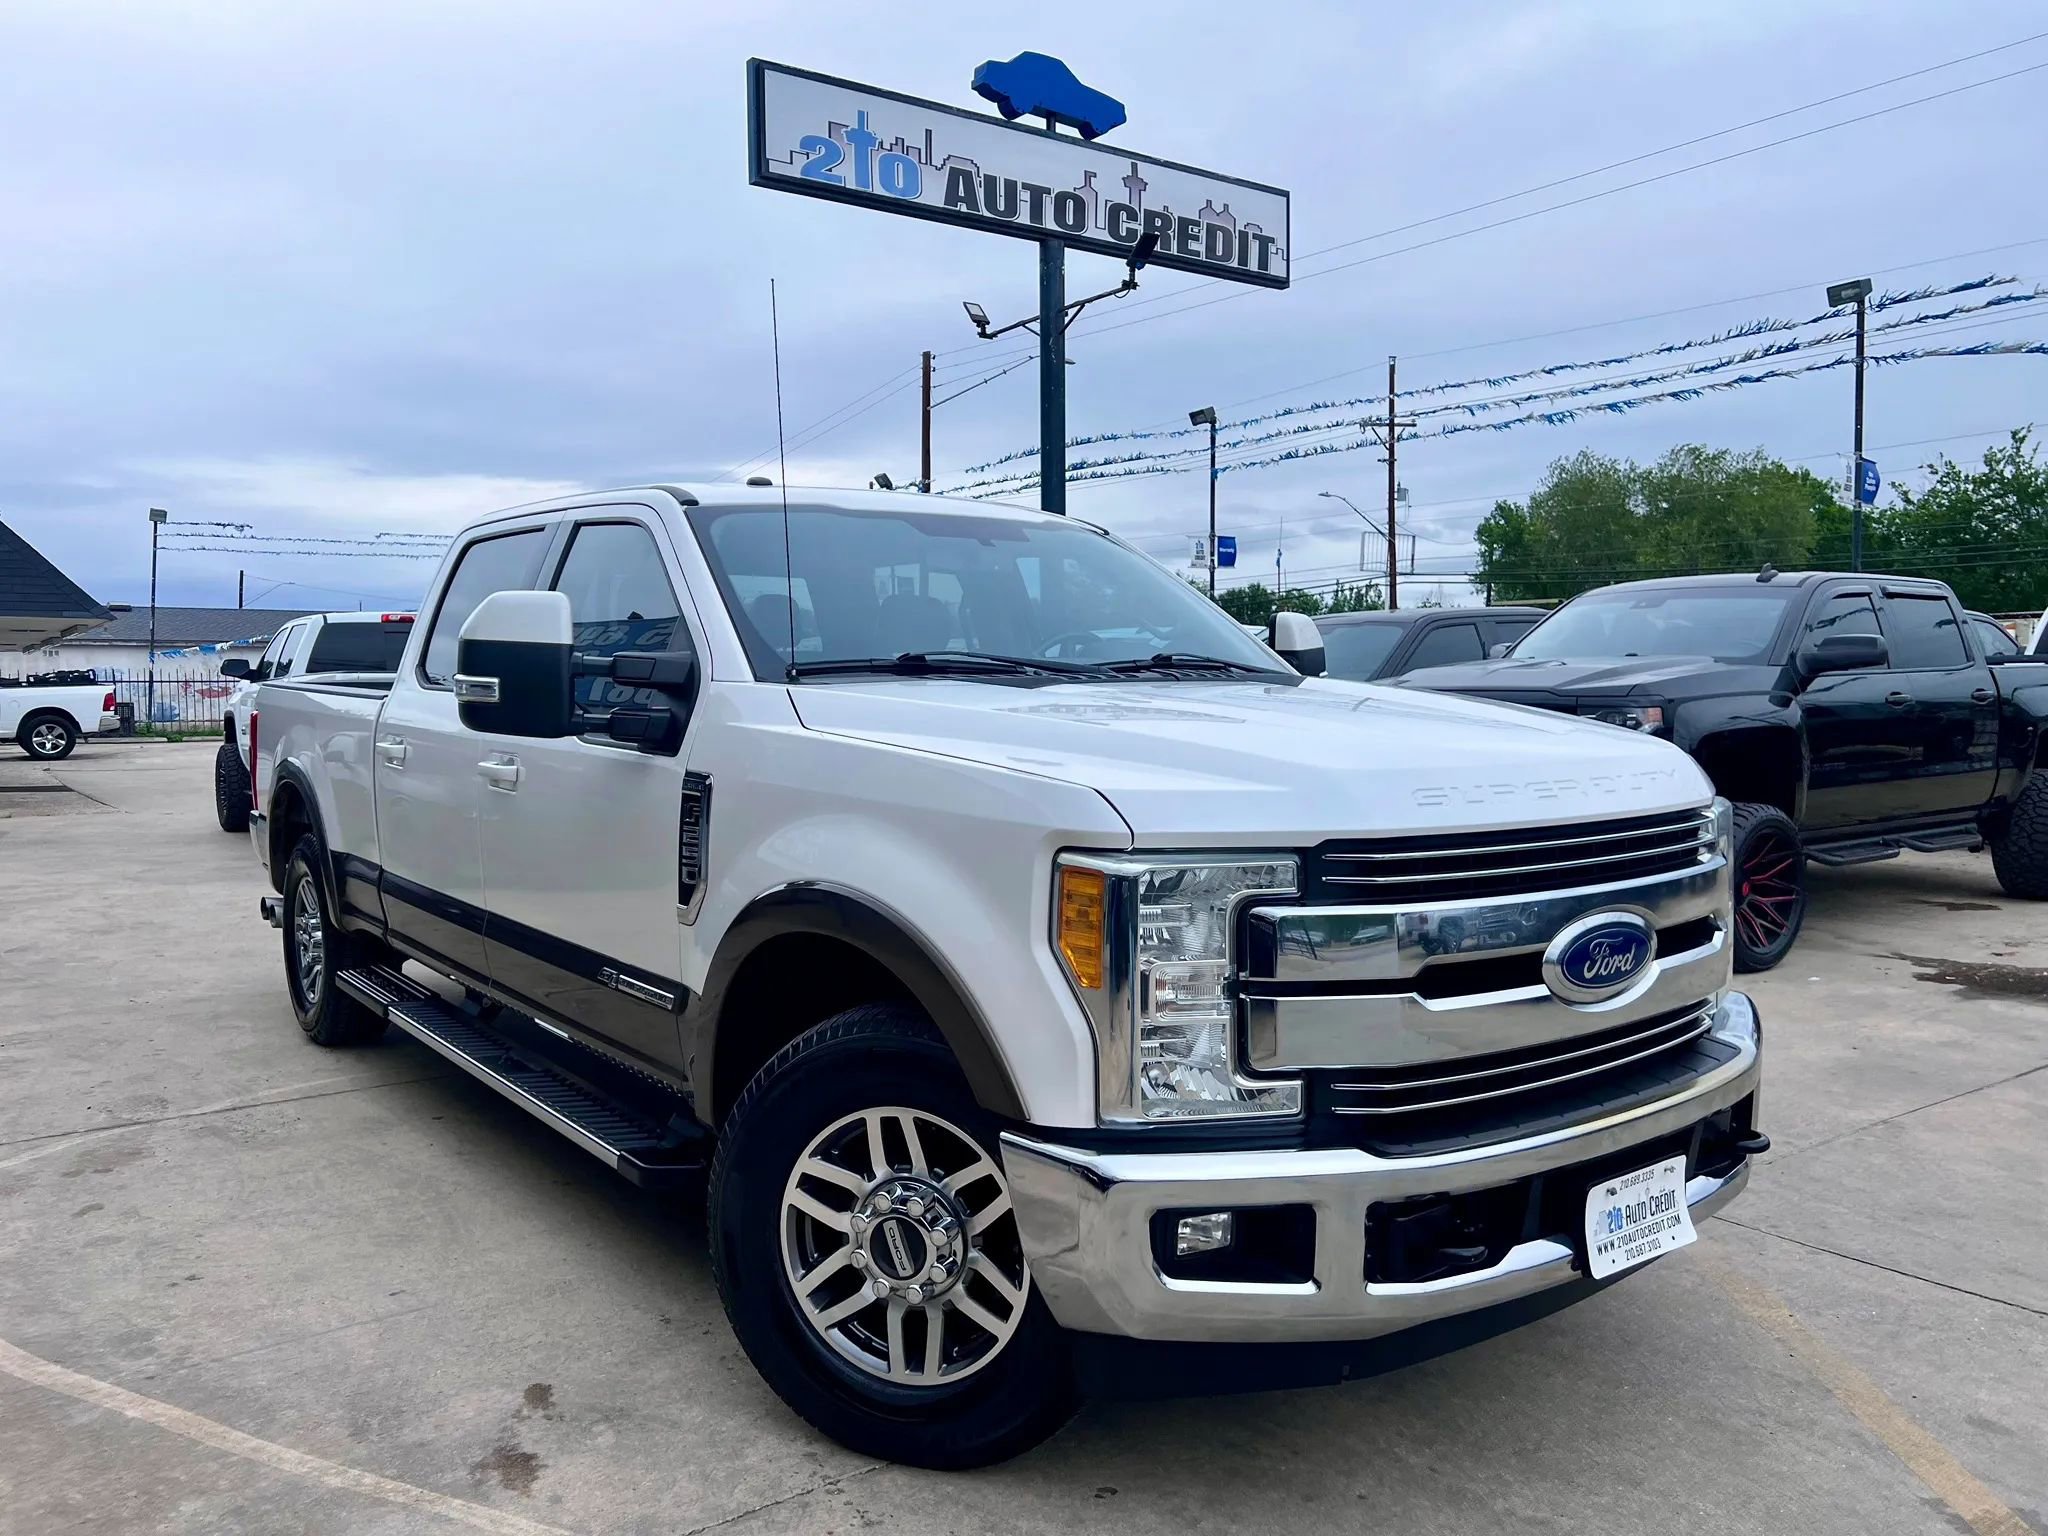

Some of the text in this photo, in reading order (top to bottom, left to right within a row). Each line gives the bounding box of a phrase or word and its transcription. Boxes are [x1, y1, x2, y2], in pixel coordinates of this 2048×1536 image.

[799, 110, 1276, 272] 210 AUTO CREDIT
[1583, 935, 1637, 979] Ford
[1606, 1205, 1625, 1234] 210
[888, 1226, 907, 1272] FORD
